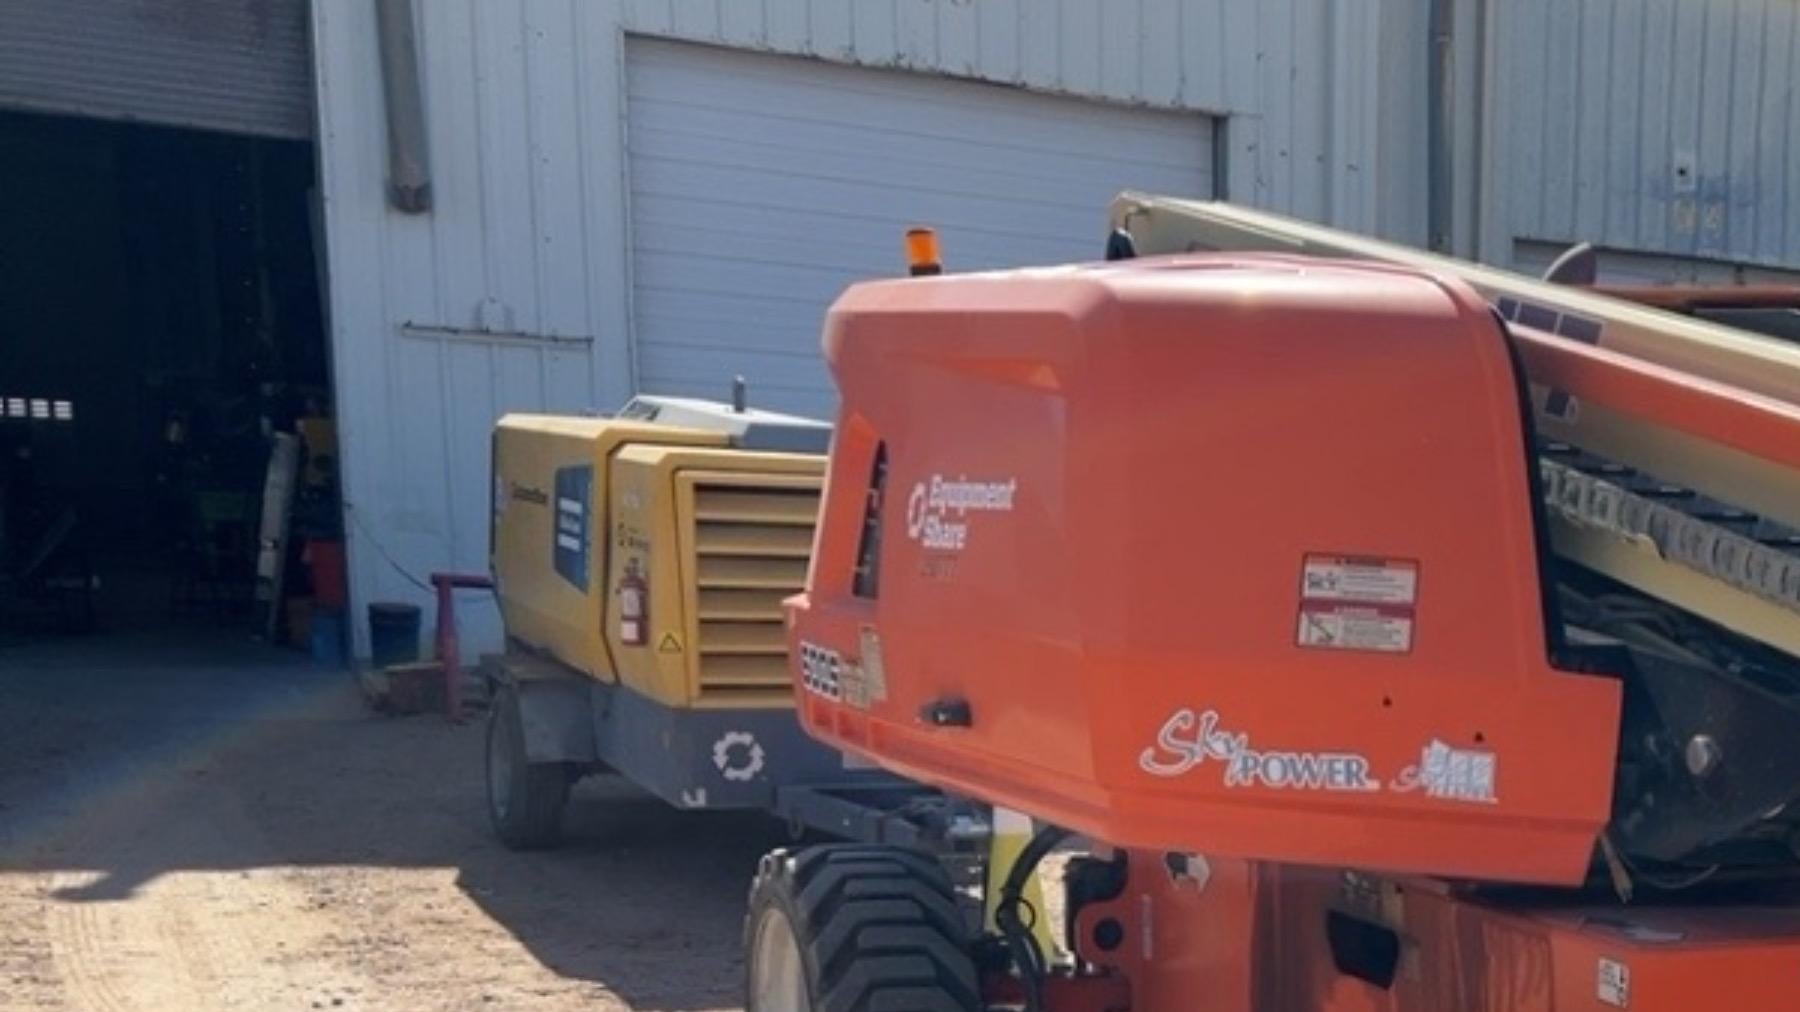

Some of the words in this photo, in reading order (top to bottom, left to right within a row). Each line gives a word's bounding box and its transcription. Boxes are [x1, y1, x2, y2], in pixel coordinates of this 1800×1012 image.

[929, 473, 1017, 515] Equipment
[922, 514, 967, 550] Share
[1139, 709, 1249, 787] Sky
[1234, 751, 1371, 791] POWER
